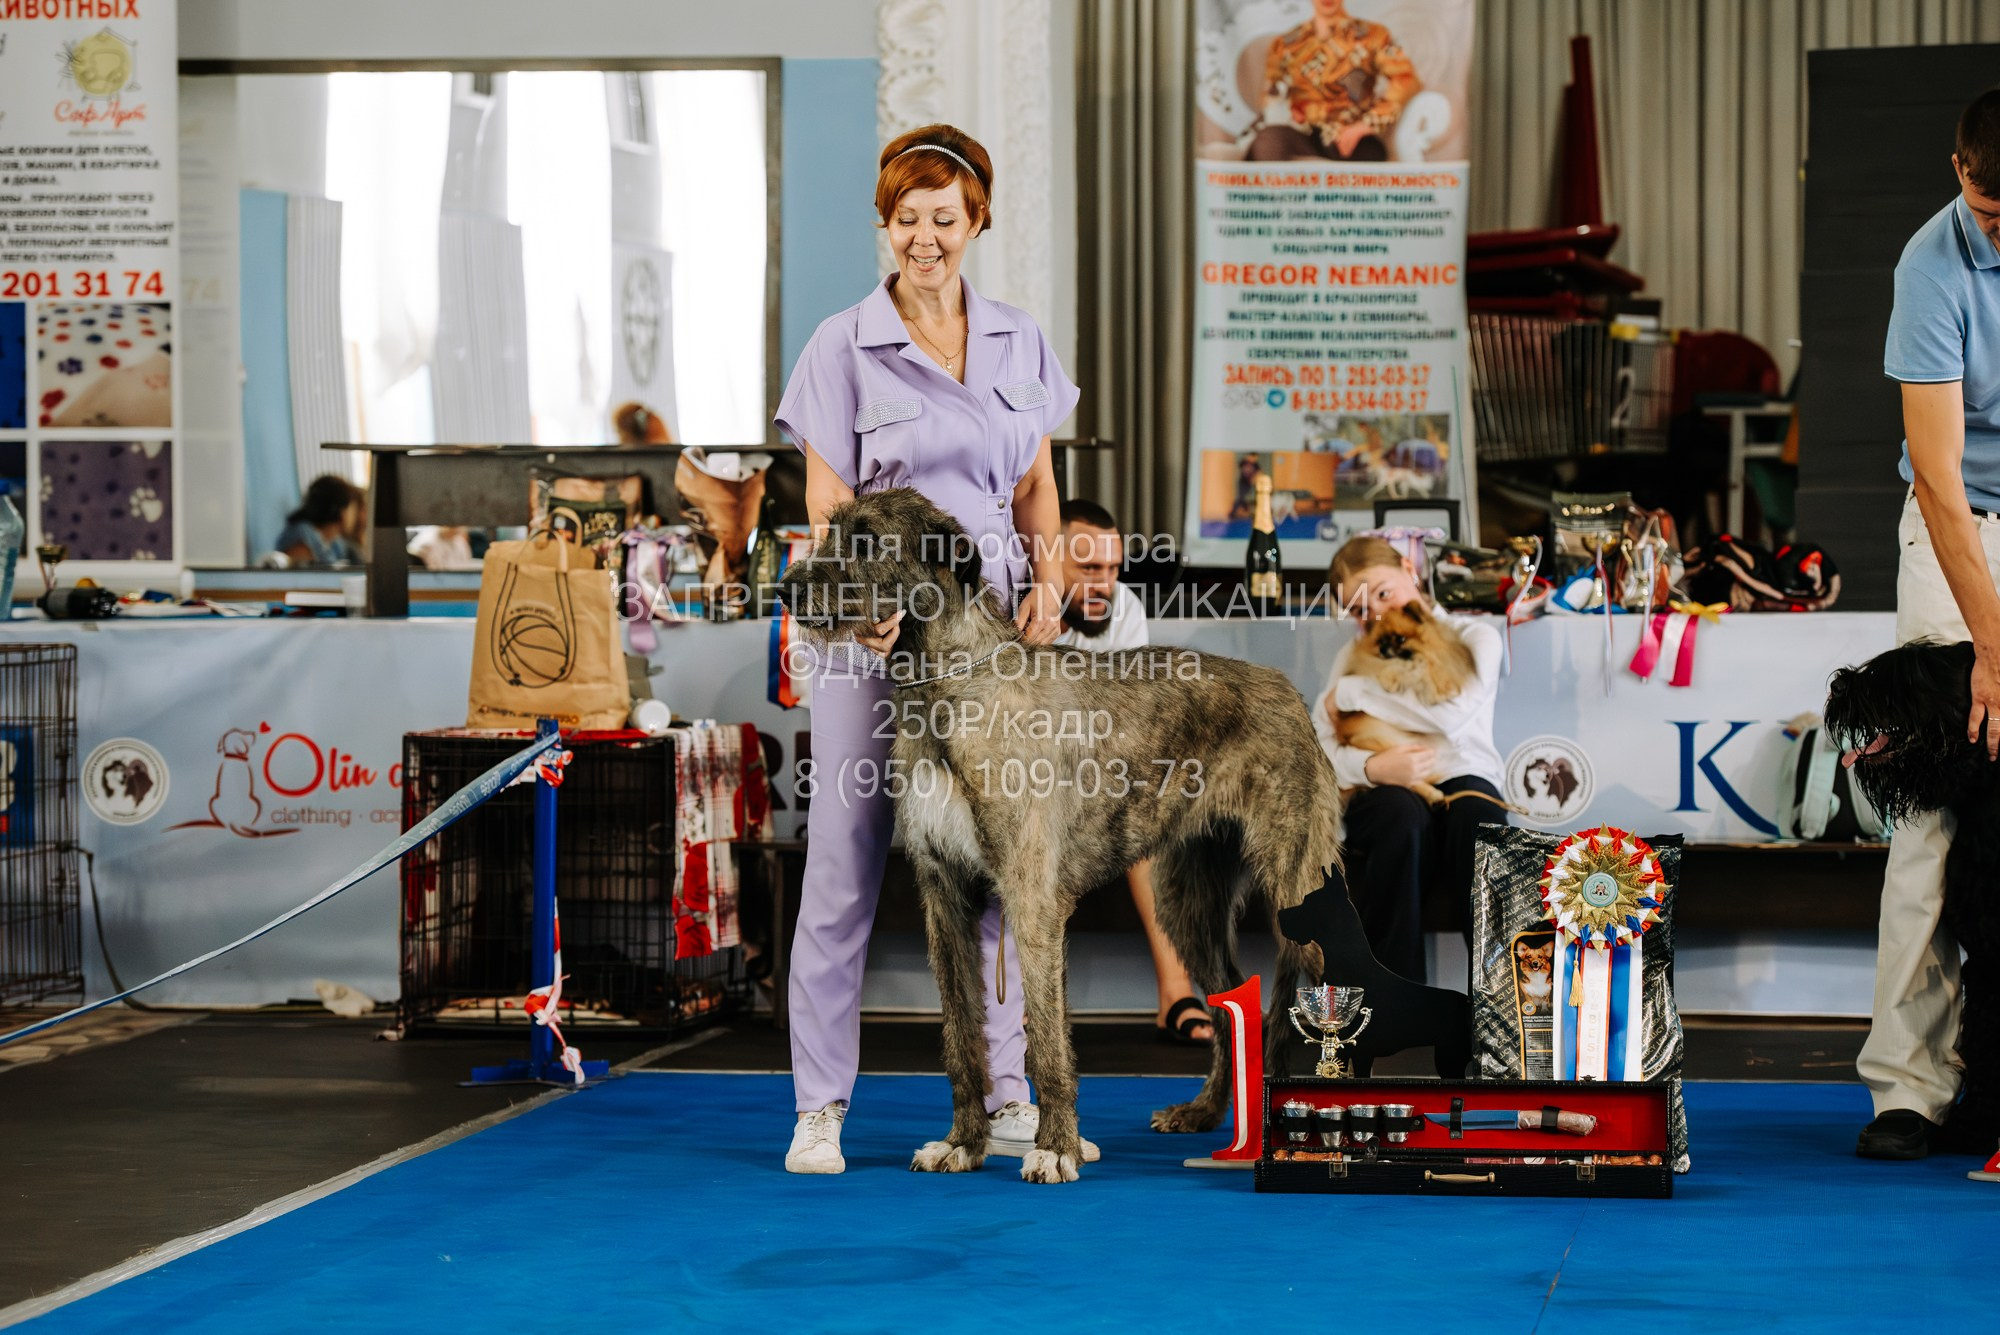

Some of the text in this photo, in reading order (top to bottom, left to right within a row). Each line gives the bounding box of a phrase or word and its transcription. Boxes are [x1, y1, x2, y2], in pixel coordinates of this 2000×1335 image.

[0, 0, 140, 20] ИВОТНЫХ
[2, 270, 165, 298] 201 31 74
[1202, 263, 1459, 286] GREGOR NEMANIC
[1223, 364, 1295, 386] ЗАПИСЬ
[1300, 364, 1324, 386] ПО
[263, 732, 378, 798] Olin
[270, 806, 353, 828] clothing
